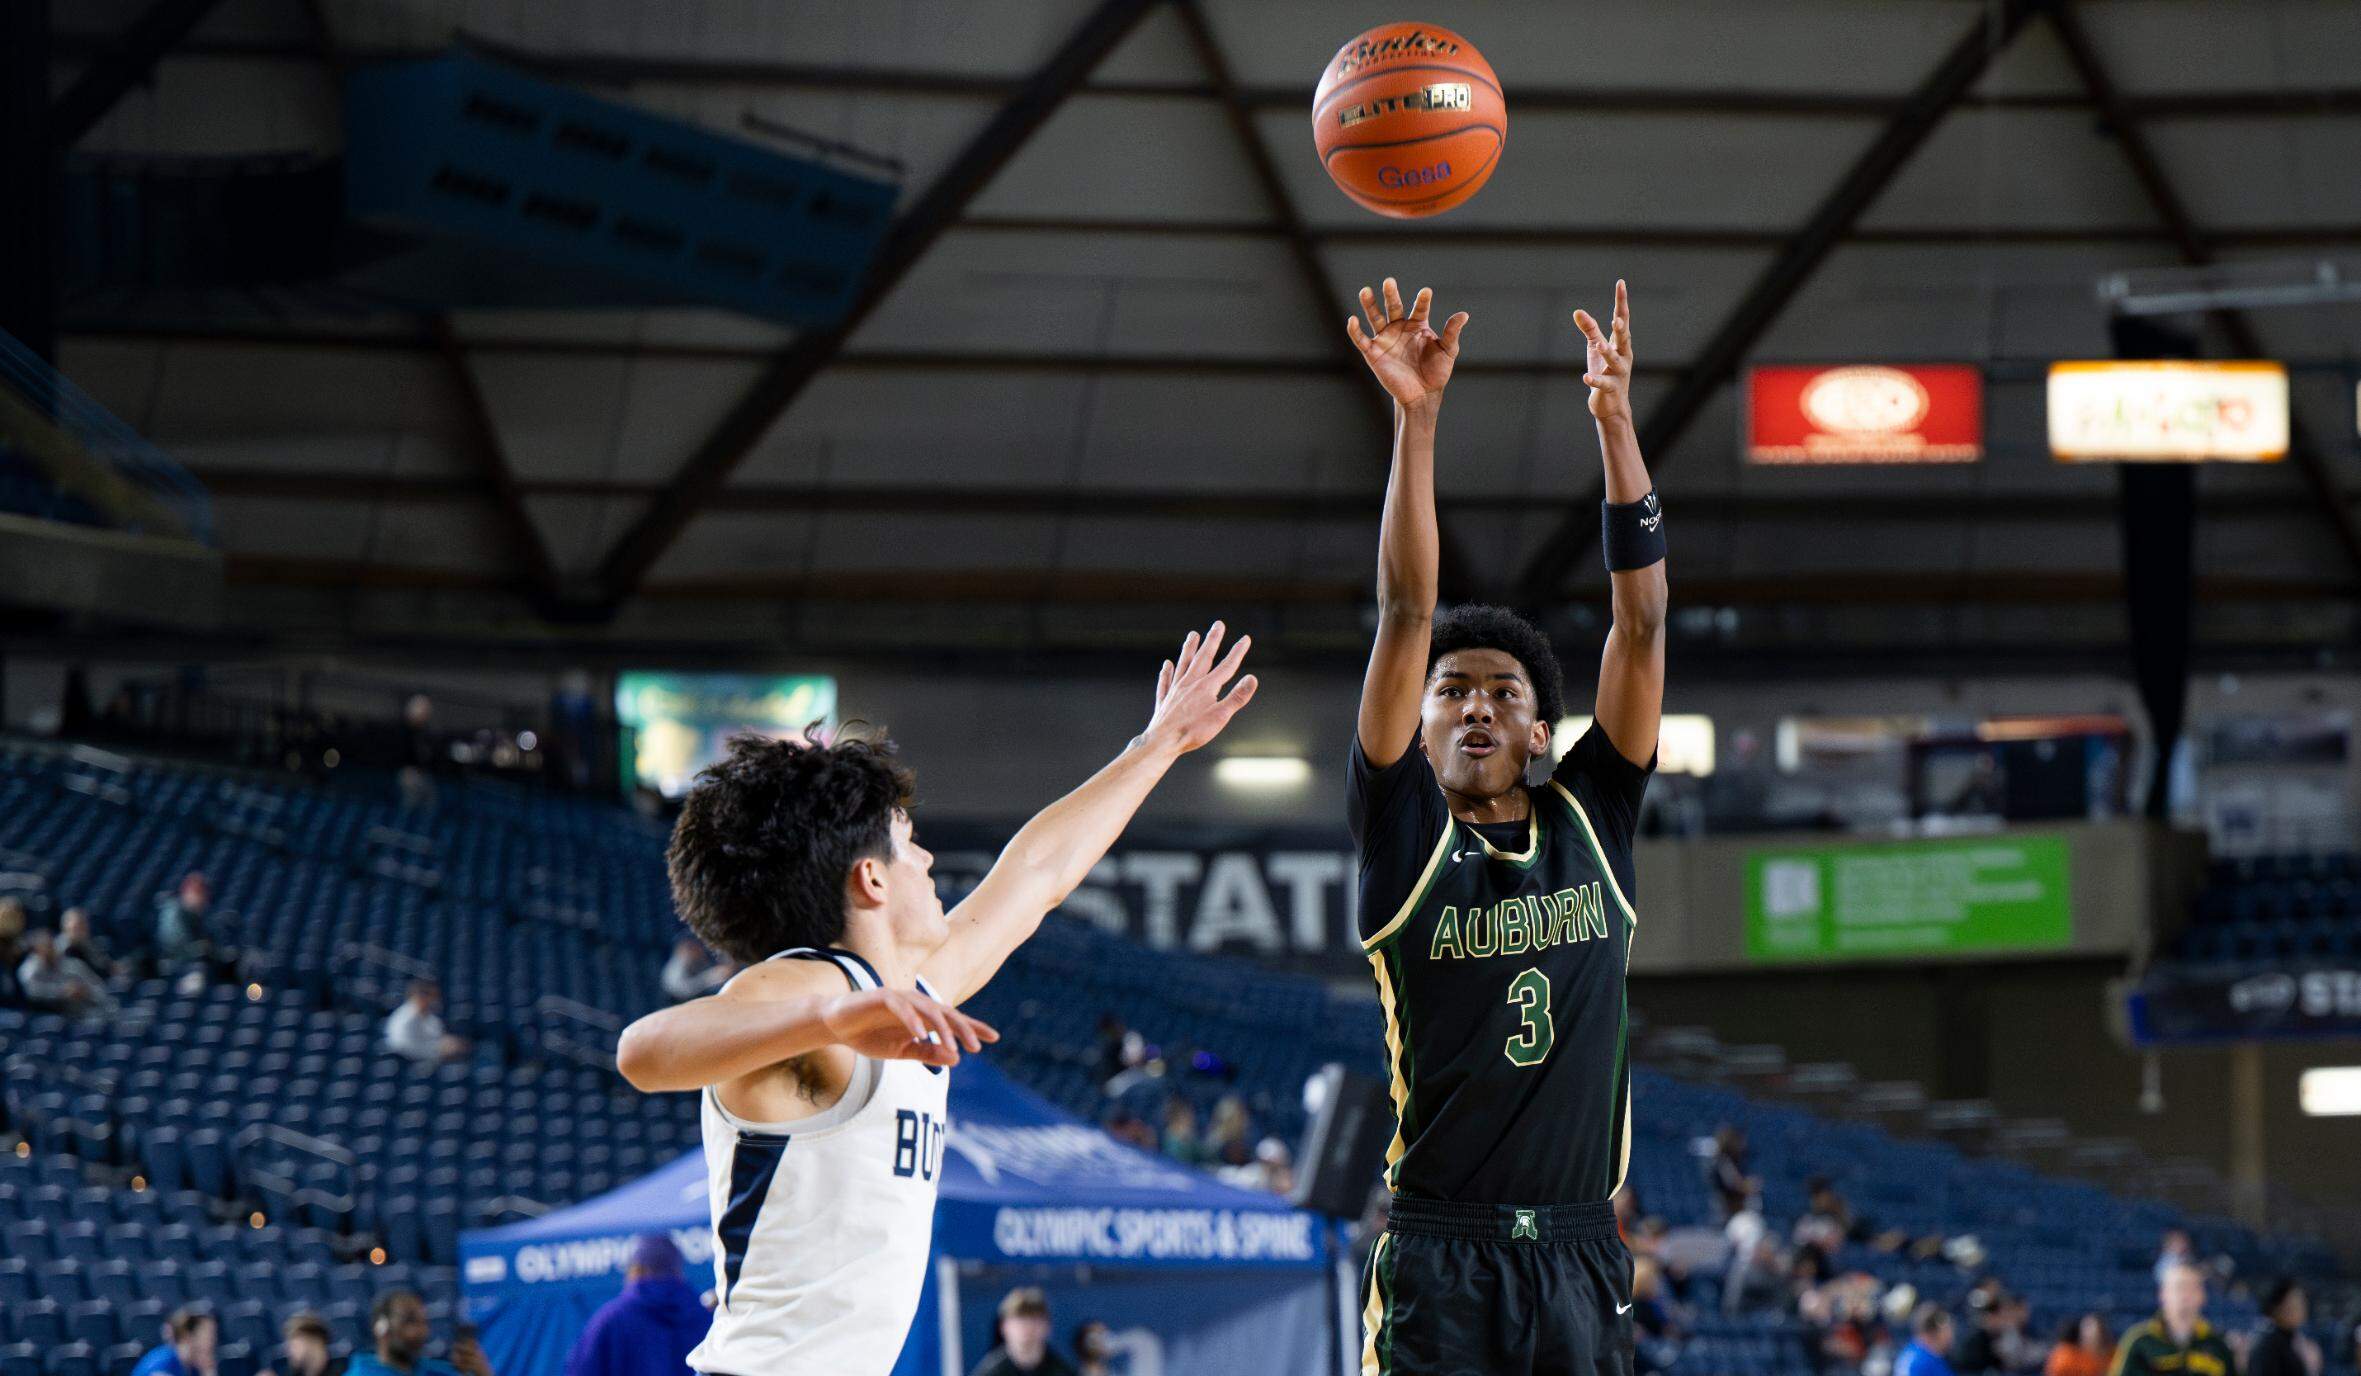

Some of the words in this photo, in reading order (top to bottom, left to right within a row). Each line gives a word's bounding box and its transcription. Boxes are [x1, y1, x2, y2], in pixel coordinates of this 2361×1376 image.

[1338, 92, 1423, 128] ELITE
[1426, 83, 1471, 112] PRO
[1430, 881, 1609, 960] AUBURN
[1504, 967, 1555, 1067] 3
[994, 1207, 1115, 1257] OLYMPIC
[1117, 1208, 1214, 1259] SPORTS
